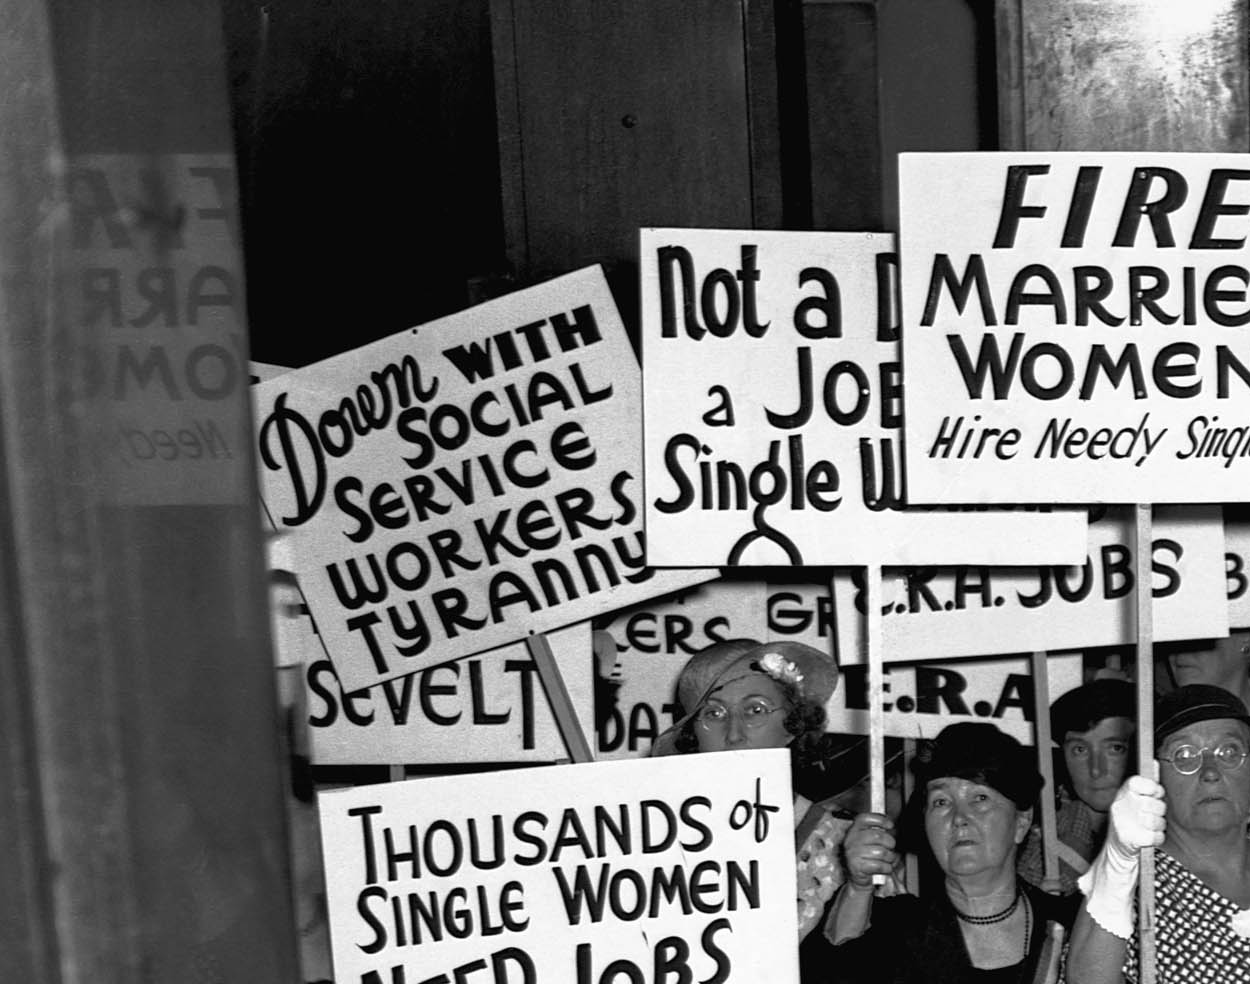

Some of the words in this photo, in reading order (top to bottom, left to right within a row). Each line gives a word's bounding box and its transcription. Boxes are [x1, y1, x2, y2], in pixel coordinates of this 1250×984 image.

[657, 245, 771, 341] Not
[794, 267, 842, 339] a
[260, 355, 438, 526] Down
[442, 304, 602, 383] WITH
[397, 363, 613, 469] SOCIAL
[702, 385, 735, 426] a
[928, 415, 1021, 460] Hire
[1034, 413, 1168, 467] Needy
[334, 421, 596, 543] SERVICE
[654, 433, 843, 565] Single
[326, 471, 637, 609] WORKERS
[347, 531, 655, 674] TYRANNY
[348, 796, 713, 884] THOUSANDS
[729, 777, 780, 843] of
[356, 881, 530, 954] SINGLE
[552, 860, 761, 925] WOMEN
